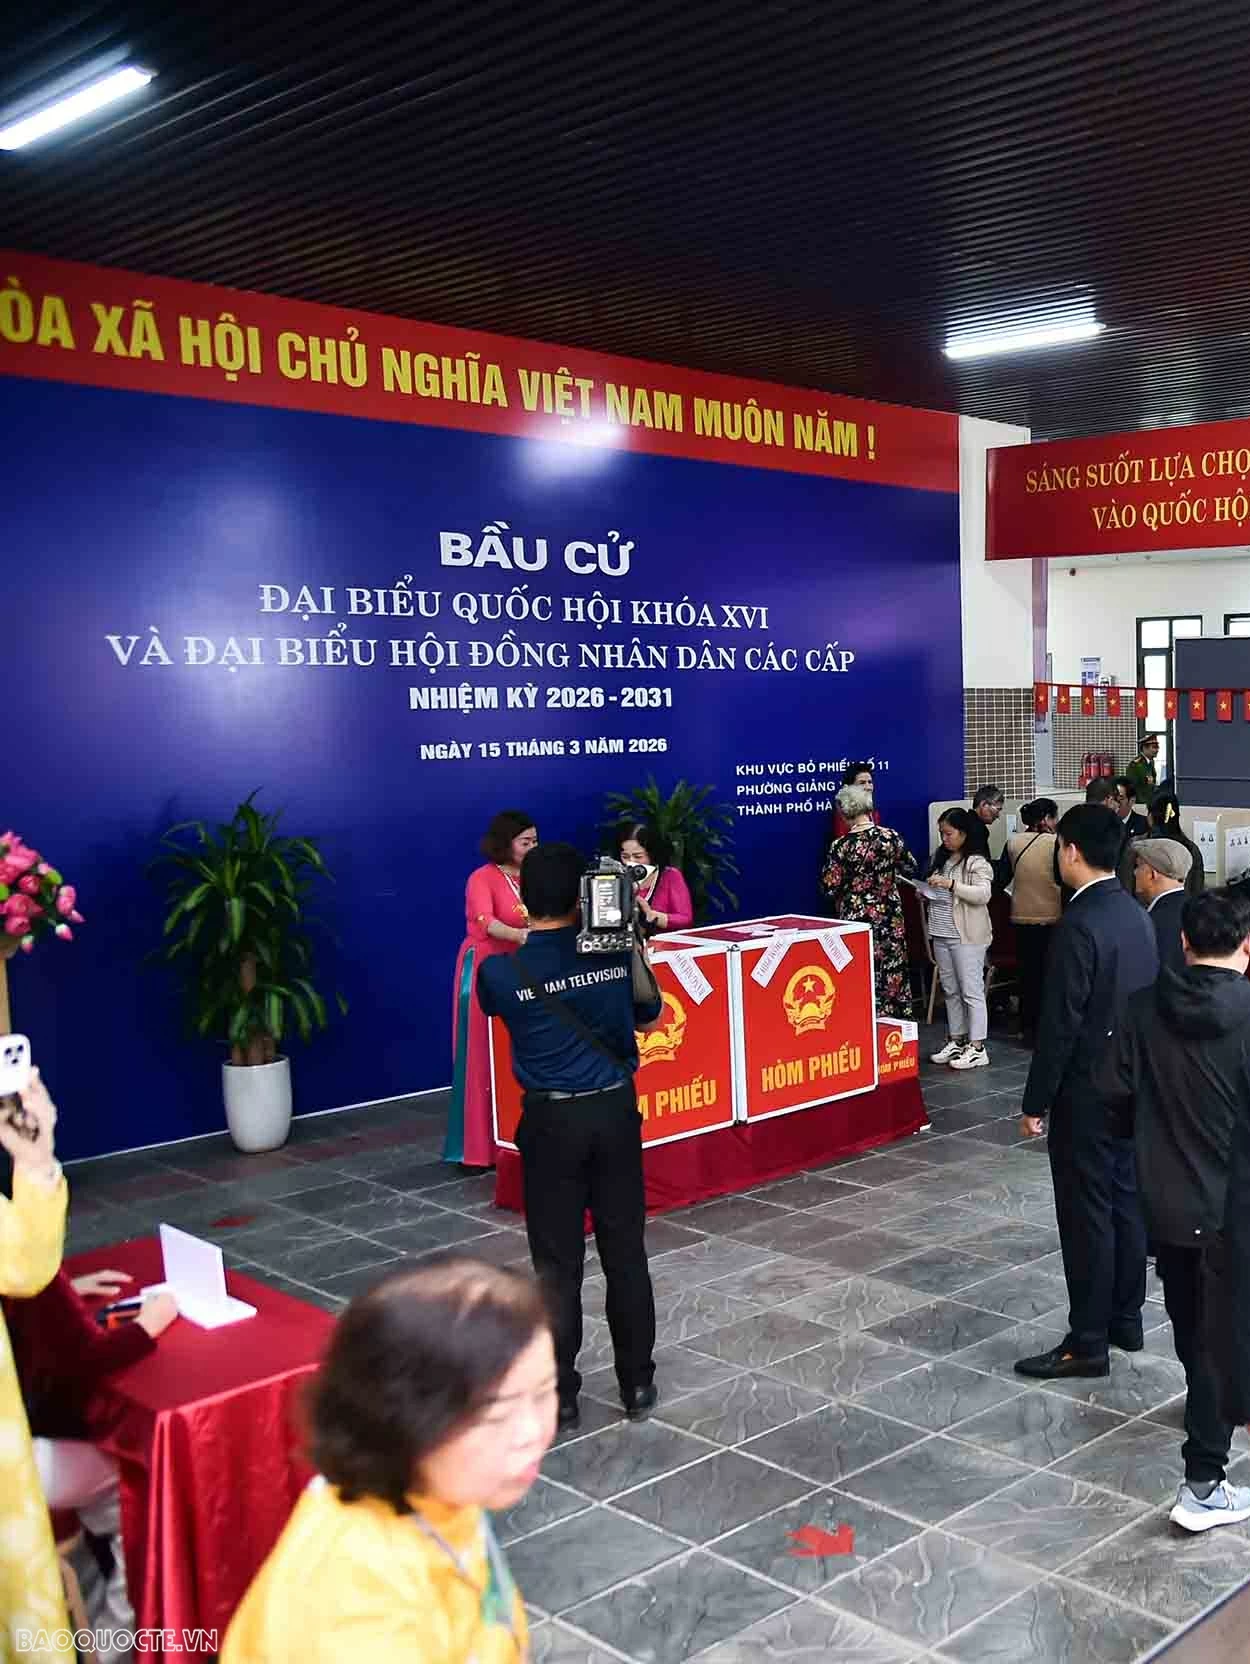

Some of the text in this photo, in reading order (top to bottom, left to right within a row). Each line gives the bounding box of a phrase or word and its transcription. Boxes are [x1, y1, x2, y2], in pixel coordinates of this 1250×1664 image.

[91, 300, 164, 360] XÃ
[180, 313, 261, 381] HỘI
[278, 327, 367, 387] CHỦ
[382, 348, 508, 407] NGHĨA
[517, 366, 596, 425] VIỆT
[605, 383, 683, 432] NAM
[694, 397, 784, 446] MUÔN
[794, 410, 857, 457] NĂM
[1026, 462, 1080, 493] SÁNG
[1086, 451, 1143, 487] SUỐT
[1150, 452, 1195, 487] LỰA
[1093, 499, 1136, 529] VÀO
[1143, 489, 1206, 531] QUỐC
[440, 521, 634, 576] BẦU CỬ
[259, 575, 768, 630] ĐẠI BIỂU QUỐC HỘI KHÓA XVI
[104, 622, 854, 674] VÀ ĐẠI BIỂU HỘI ĐỒNG NHÂN DÂN CÁC CẤP
[410, 683, 498, 713] NHIỆM
[507, 683, 538, 708] KỲ
[421, 737, 667, 759] NGÀY 15 THÁNG 3 NĂM 2026
[736, 765, 763, 775] KHU
[768, 763, 793, 775] VỰC
[798, 760, 815, 773] BỎ
[819, 758, 850, 772] PHIẾ
[878, 761, 888, 770] 11
[737, 782, 792, 795] PHƯỜNG
[796, 779, 835, 792] GIẢNG
[737, 798, 832, 816] THÀNH PHỐ HÀ
[515, 967, 627, 1002] VIEAM TELEVISION
[761, 1041, 860, 1092] HÒM PHIẾU
[656, 1074, 716, 1116] PHIẾU
